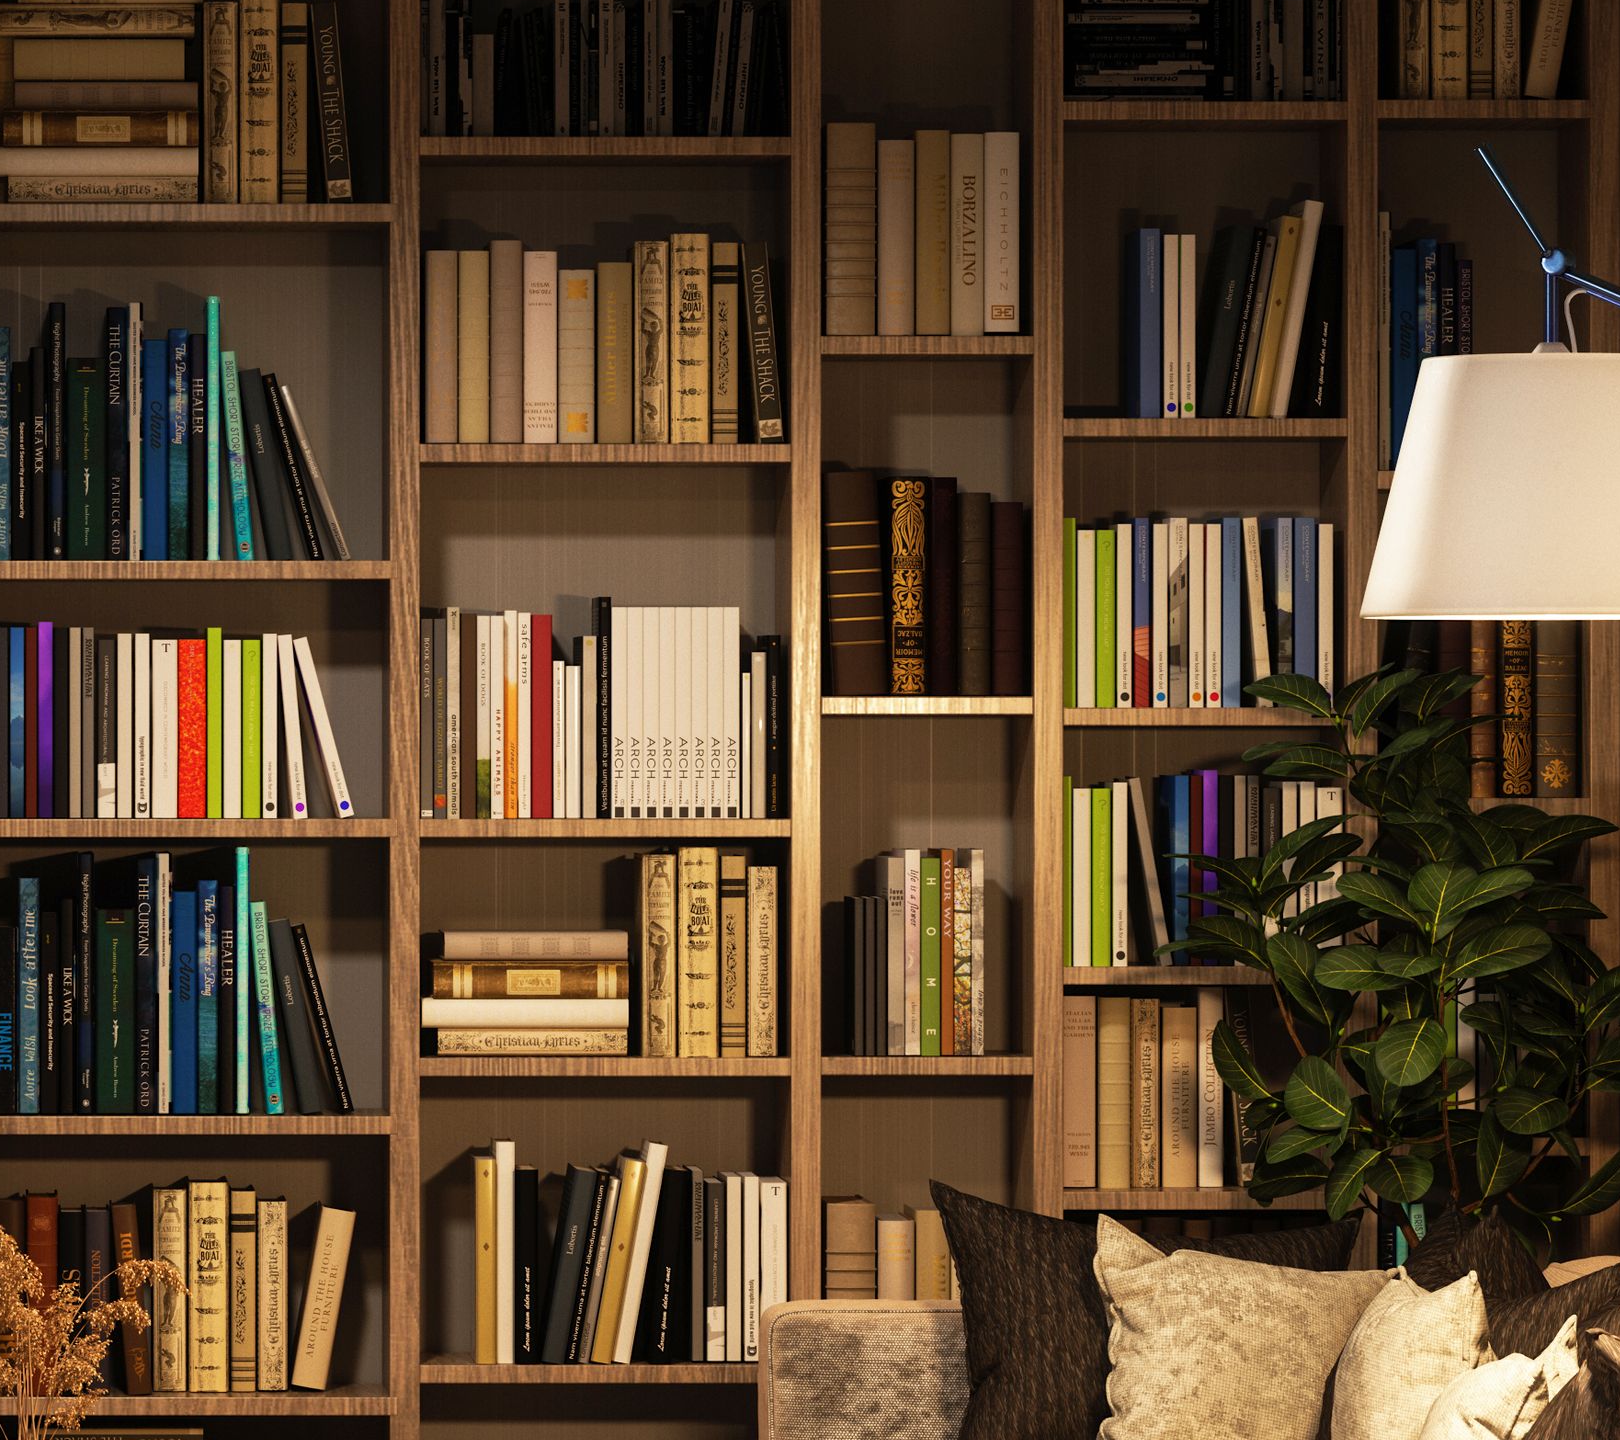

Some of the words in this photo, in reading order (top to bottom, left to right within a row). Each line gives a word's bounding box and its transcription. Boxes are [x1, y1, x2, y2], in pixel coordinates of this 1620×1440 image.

[962, 176, 976, 285] BORZALINO
[1000, 168, 1008, 291] EICHHOLTZ
[751, 265, 766, 313] YOUNG
[1224, 280, 1235, 310] Lobortis
[1442, 287, 1453, 344] HEALER
[110, 325, 120, 349] THE
[175, 344, 186, 360] The
[754, 328, 771, 355] THE
[52, 341, 61, 382] Photography
[109, 351, 122, 405] CURTAIN
[225, 360, 235, 394] BRISTOL
[757, 359, 775, 403] SHACK
[174, 362, 186, 420] Pawnbroker's
[192, 378, 203, 433] HEALER
[227, 396, 237, 425] SHORT
[35, 416, 43, 434] LIKE
[35, 436, 43, 445] A
[151, 401, 164, 449] Anna
[173, 422, 186, 444] Ring
[35, 447, 43, 473] WICK
[111, 477, 121, 525] PATRICK
[111, 530, 121, 555] ORD
[424, 664, 430, 674] OF
[221, 929, 232, 986] HEALER
[1204, 1107, 1217, 1147] JUMBO
[566, 1224, 578, 1255] Lobortis
[306, 1307, 321, 1357] AROUND
[315, 1279, 325, 1302] THE
[320, 1234, 334, 1274] HOUSE
[320, 1264, 339, 1332] FURNITURE
